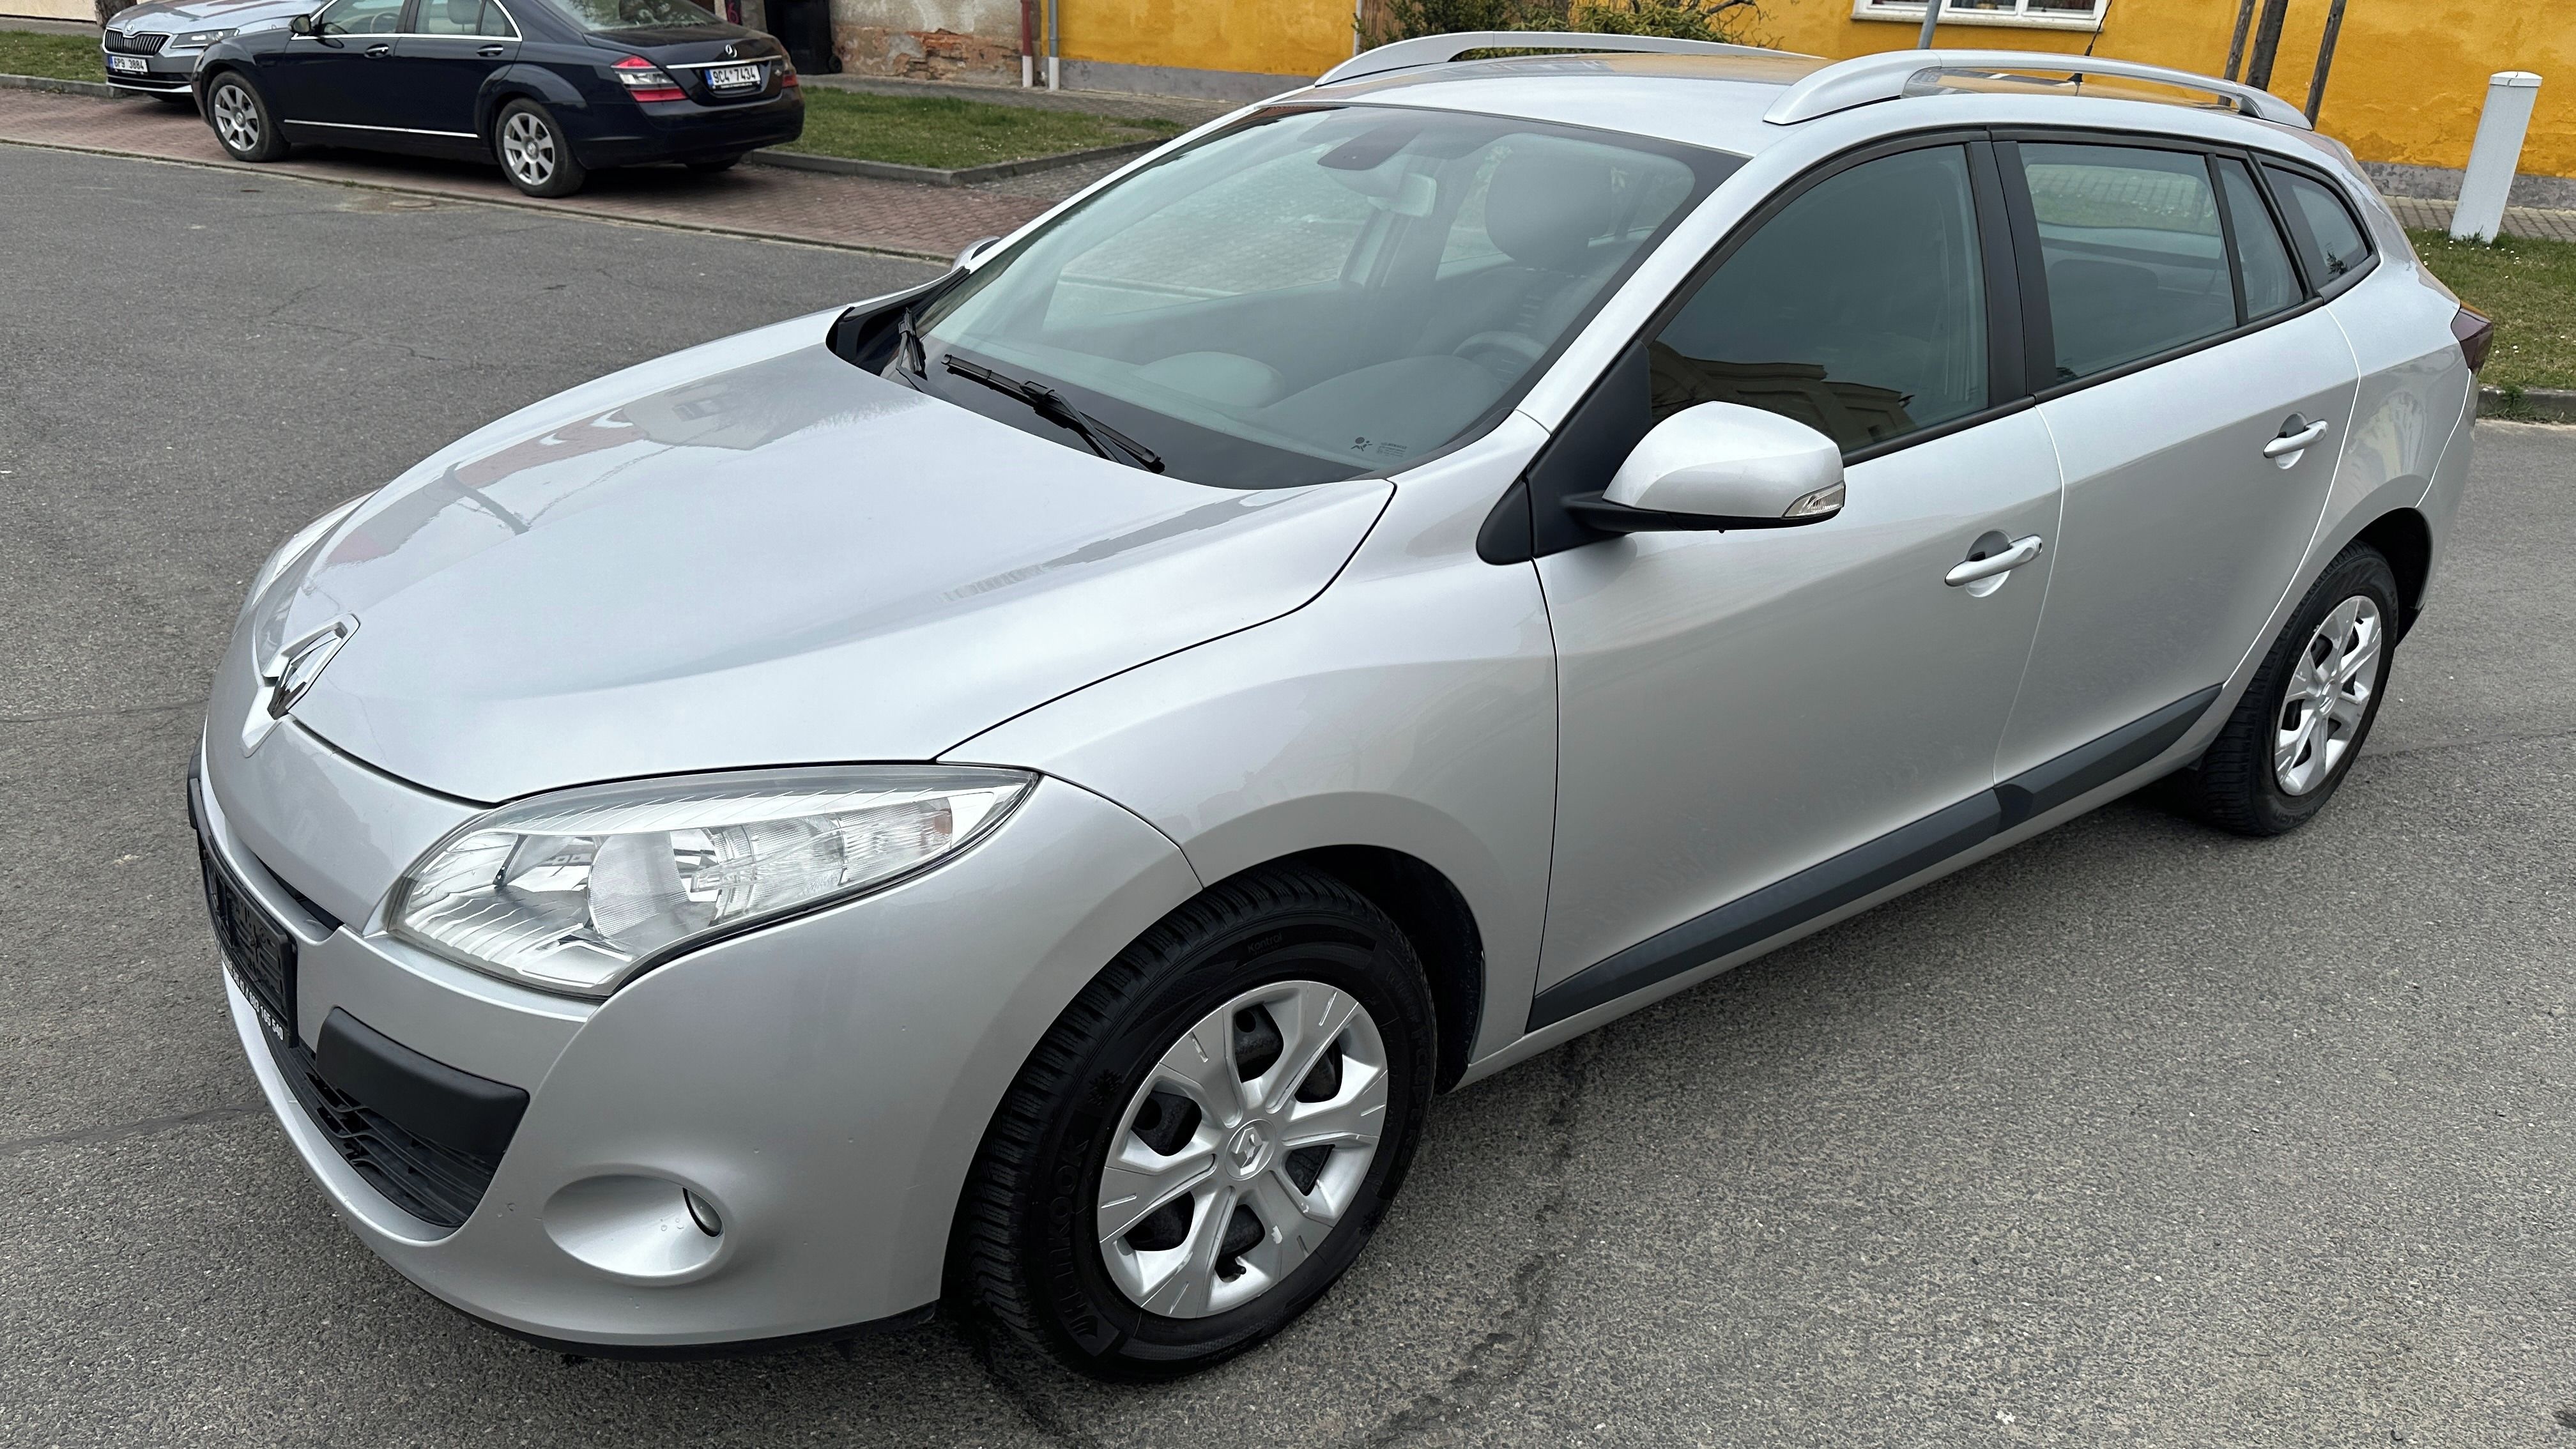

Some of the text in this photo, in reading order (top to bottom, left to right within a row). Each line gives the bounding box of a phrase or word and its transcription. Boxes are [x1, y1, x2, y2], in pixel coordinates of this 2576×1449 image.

[713, 67, 756, 83] 9C4 7434
[1247, 930, 1283, 954] Kontrol
[260, 1006, 271, 1027] 165
[272, 1018, 284, 1041] 540
